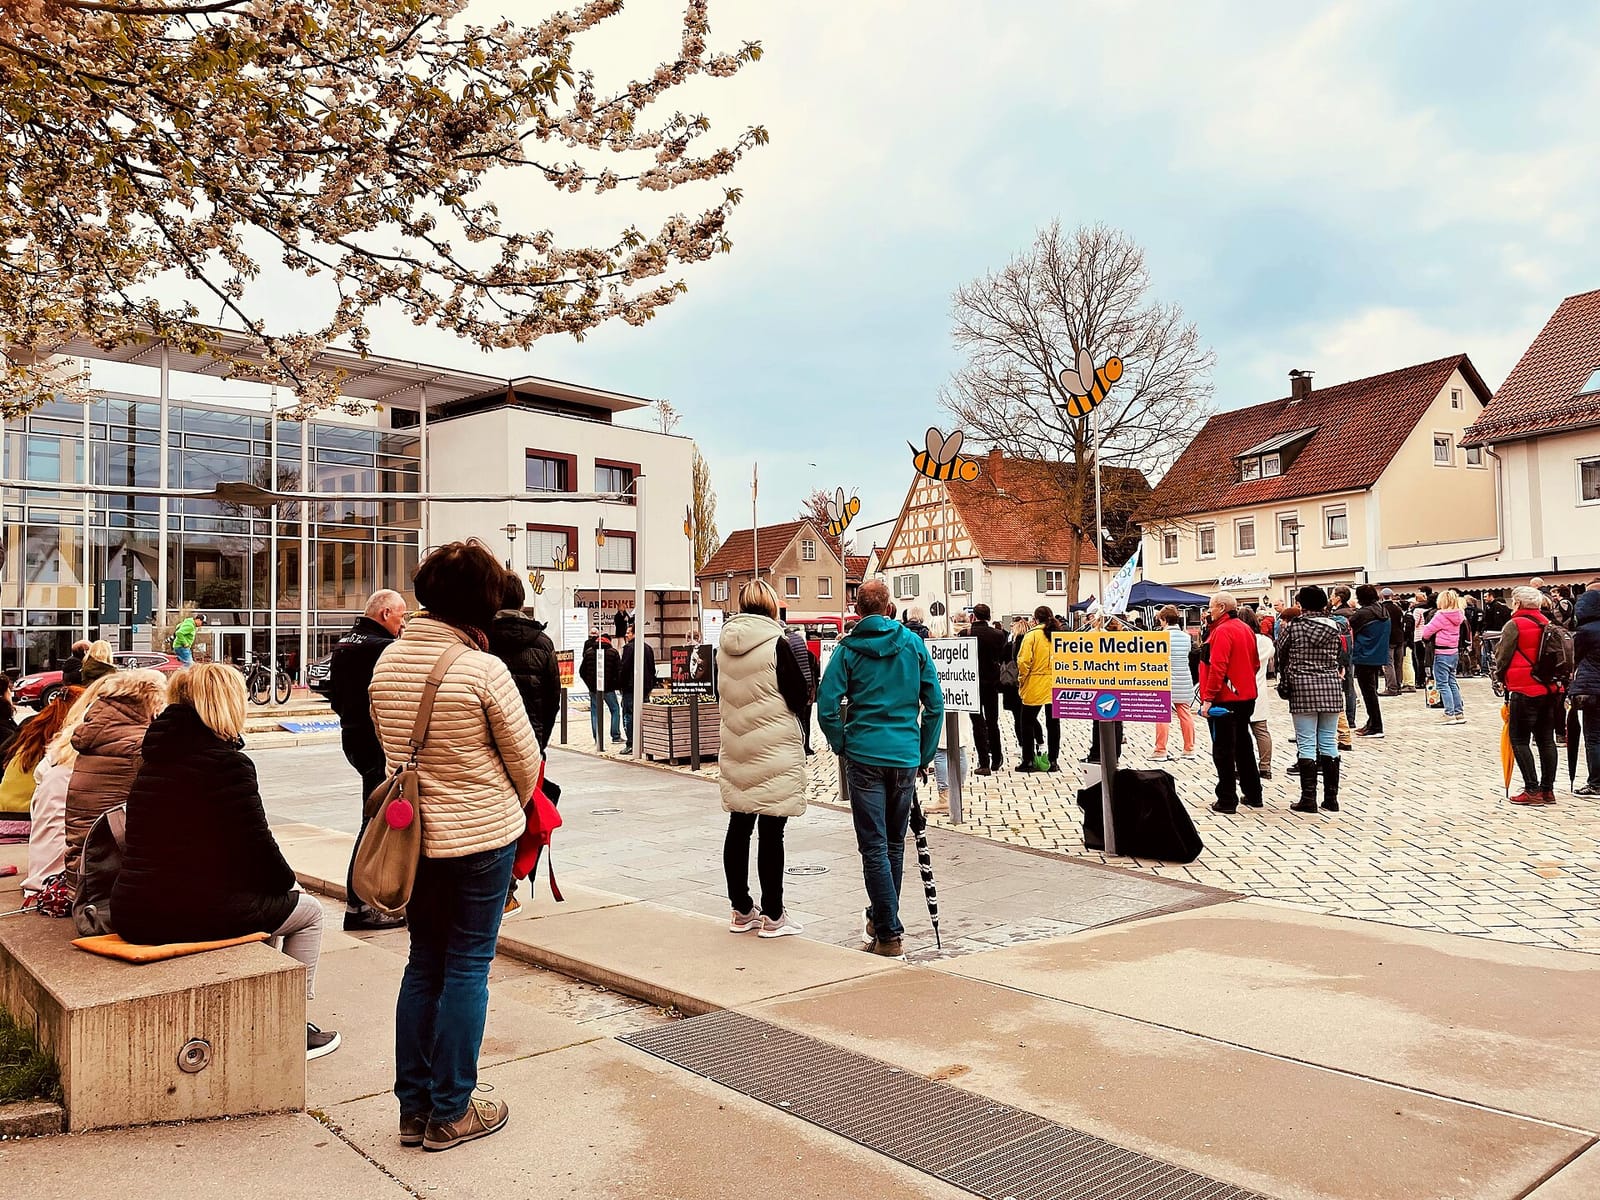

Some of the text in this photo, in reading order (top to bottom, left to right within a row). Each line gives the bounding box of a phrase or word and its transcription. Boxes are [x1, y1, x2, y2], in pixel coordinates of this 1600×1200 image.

[1054, 637, 1167, 653] Freie Medien
[931, 643, 969, 664] Bargeld
[1054, 660, 1168, 672] Die 5. Macht im Staat
[937, 668, 976, 683] gedruckte
[1055, 676, 1168, 686] Alternativ und umfassend
